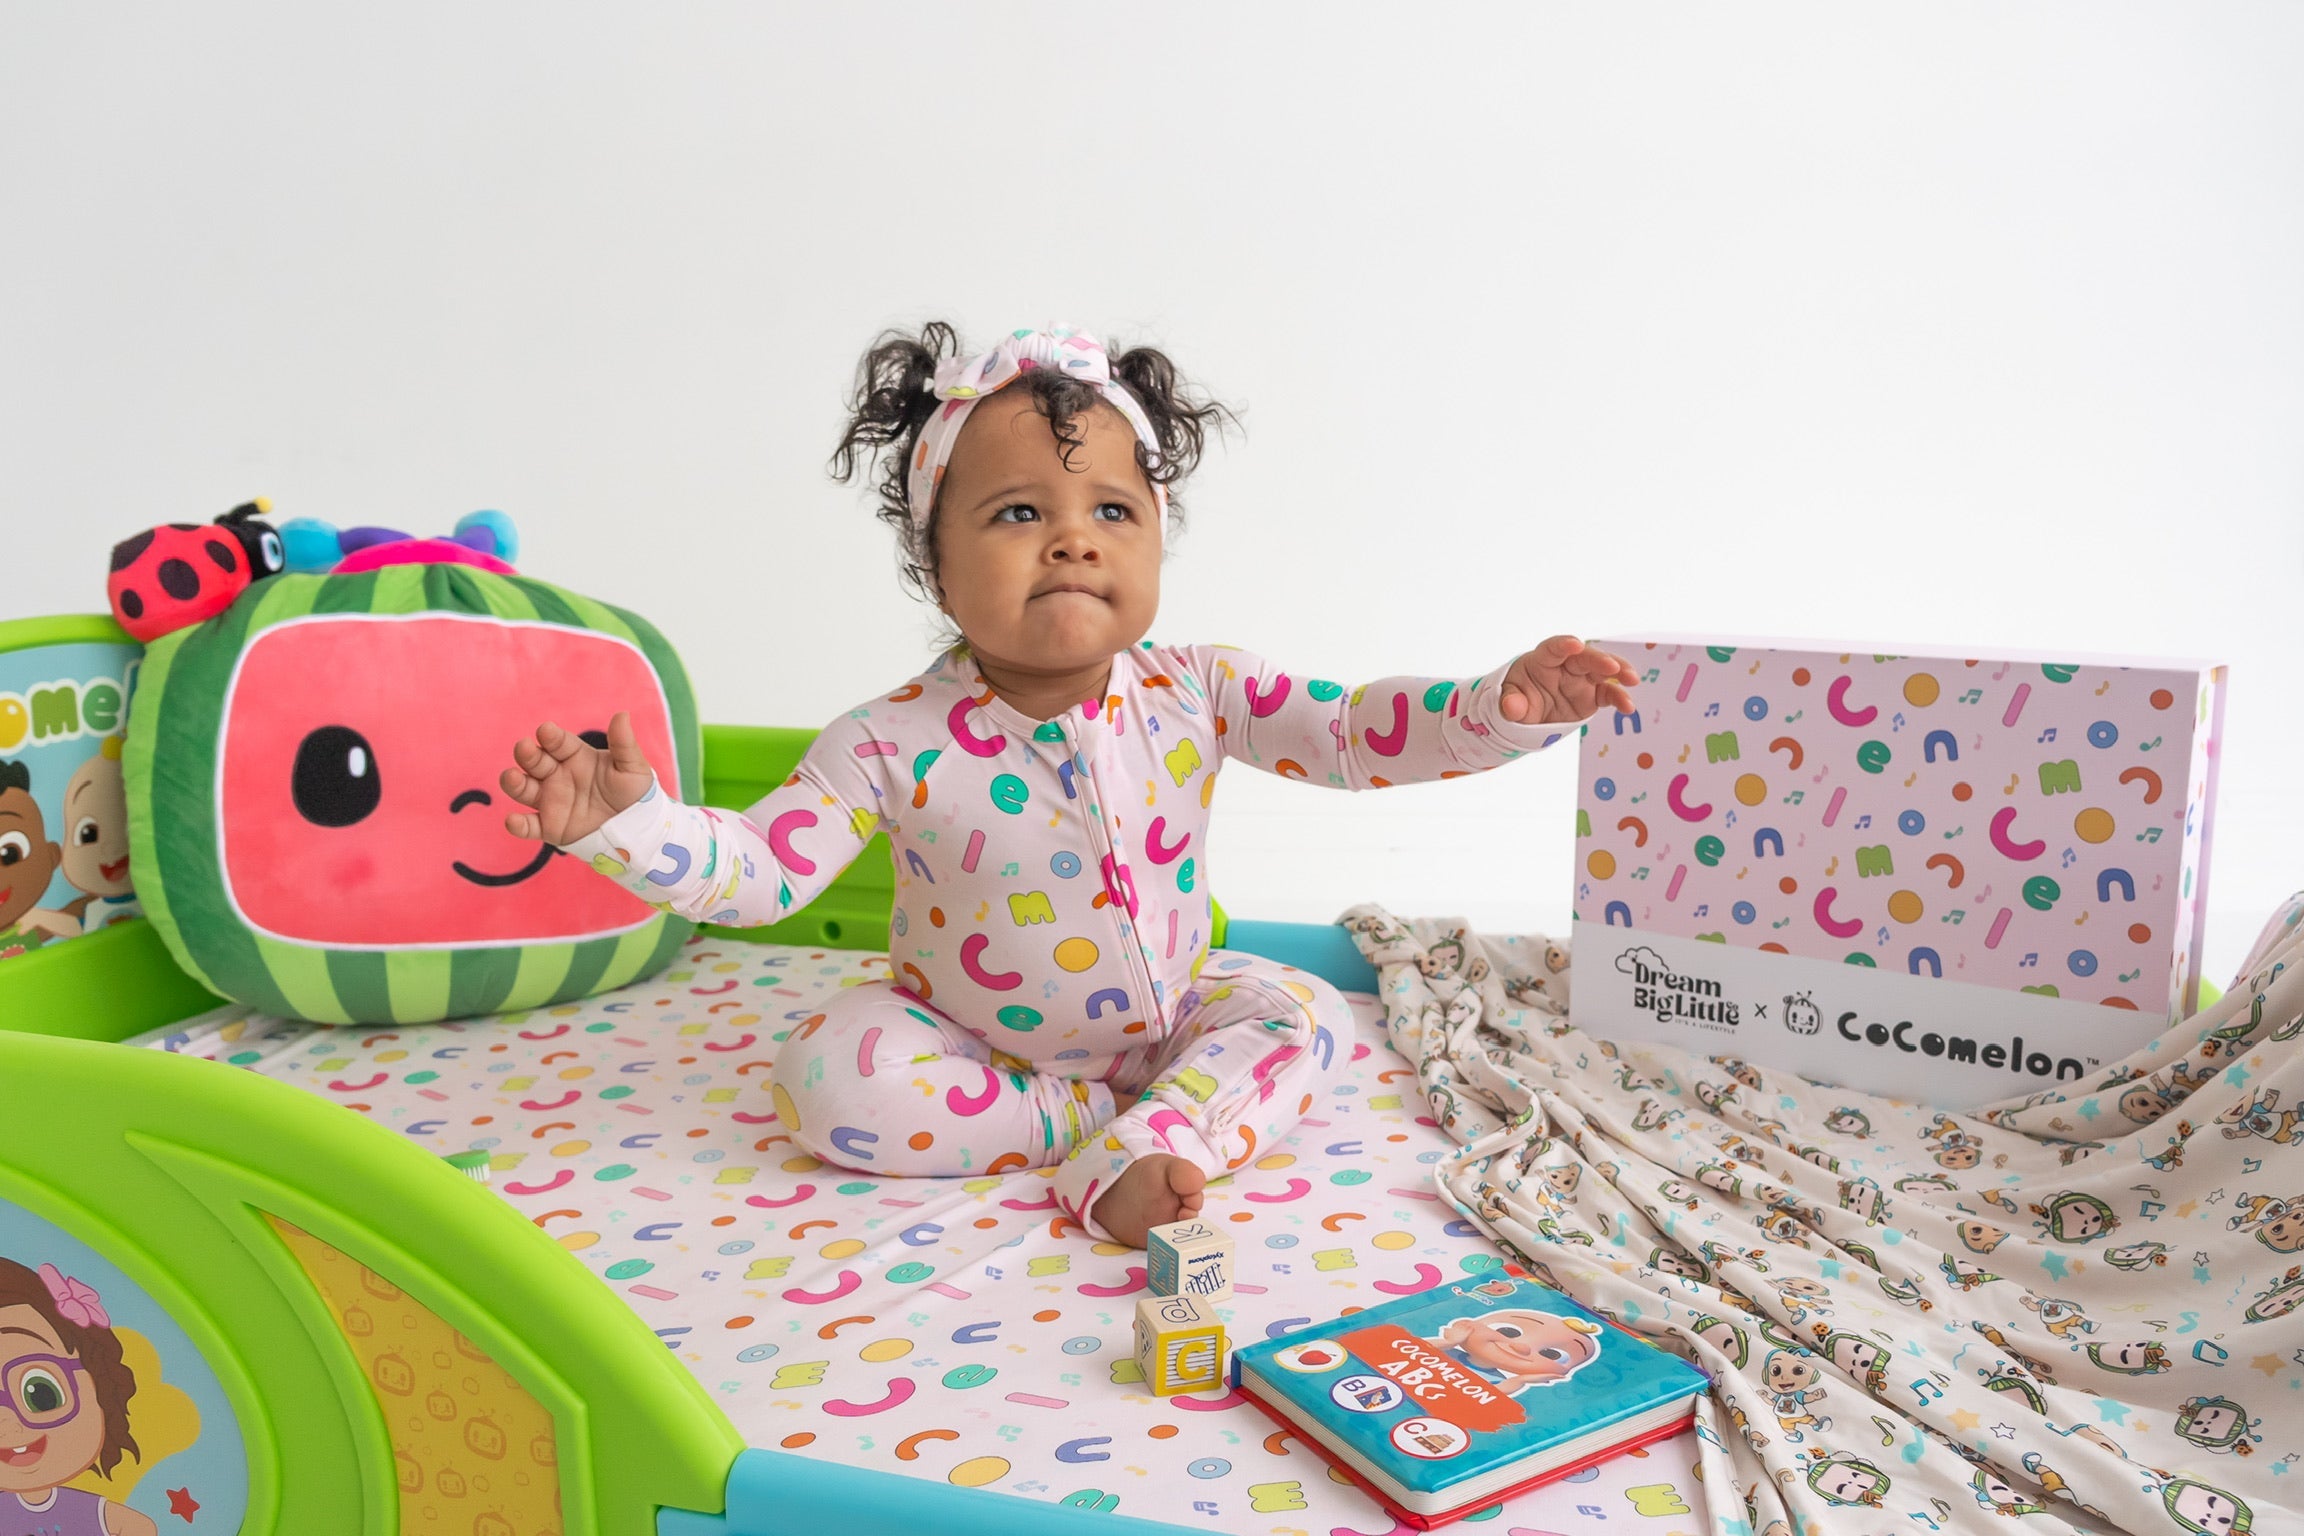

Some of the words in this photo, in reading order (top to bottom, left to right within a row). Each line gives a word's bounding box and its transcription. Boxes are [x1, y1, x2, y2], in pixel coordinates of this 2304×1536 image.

[1635, 962, 1722, 998] Dream
[1837, 1011, 2084, 1081] CoComelon
[1341, 1379, 1367, 1392] B
[1391, 1339, 1497, 1405] COCOMELON
